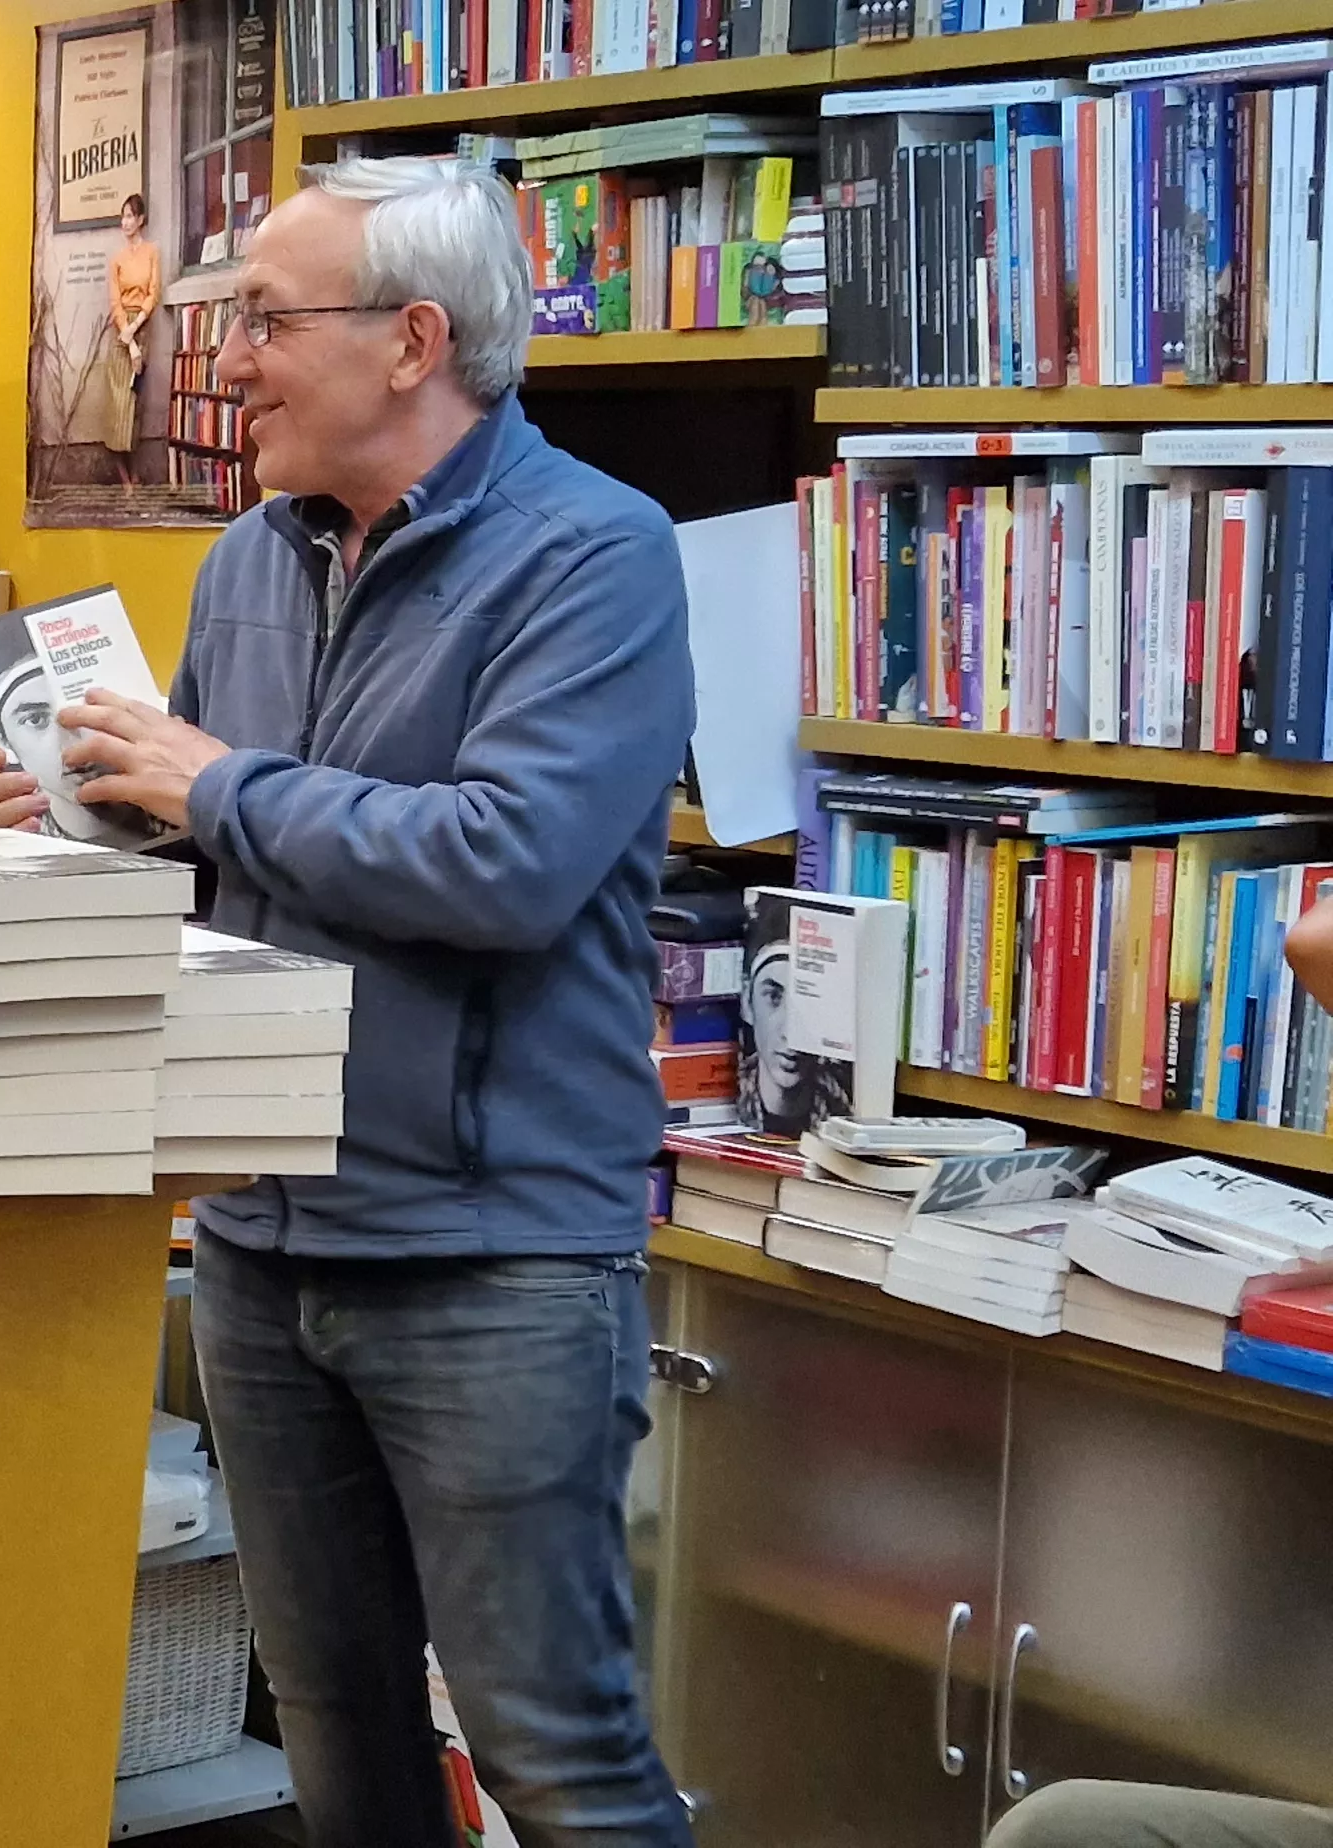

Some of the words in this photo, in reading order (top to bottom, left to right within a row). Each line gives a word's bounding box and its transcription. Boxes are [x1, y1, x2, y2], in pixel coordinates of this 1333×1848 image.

[62, 125, 139, 185] LIBRERÍA
[38, 616, 73, 634] Rocío
[43, 624, 100, 648] Lardinois
[48, 648, 70, 663] Los
[71, 635, 112, 657] chicos
[53, 656, 99, 676] tuertos
[967, 922, 981, 1019] WALKSCAPES
[1166, 1001, 1182, 1065] RESPUESTA
[1165, 1067, 1177, 1083] LA
